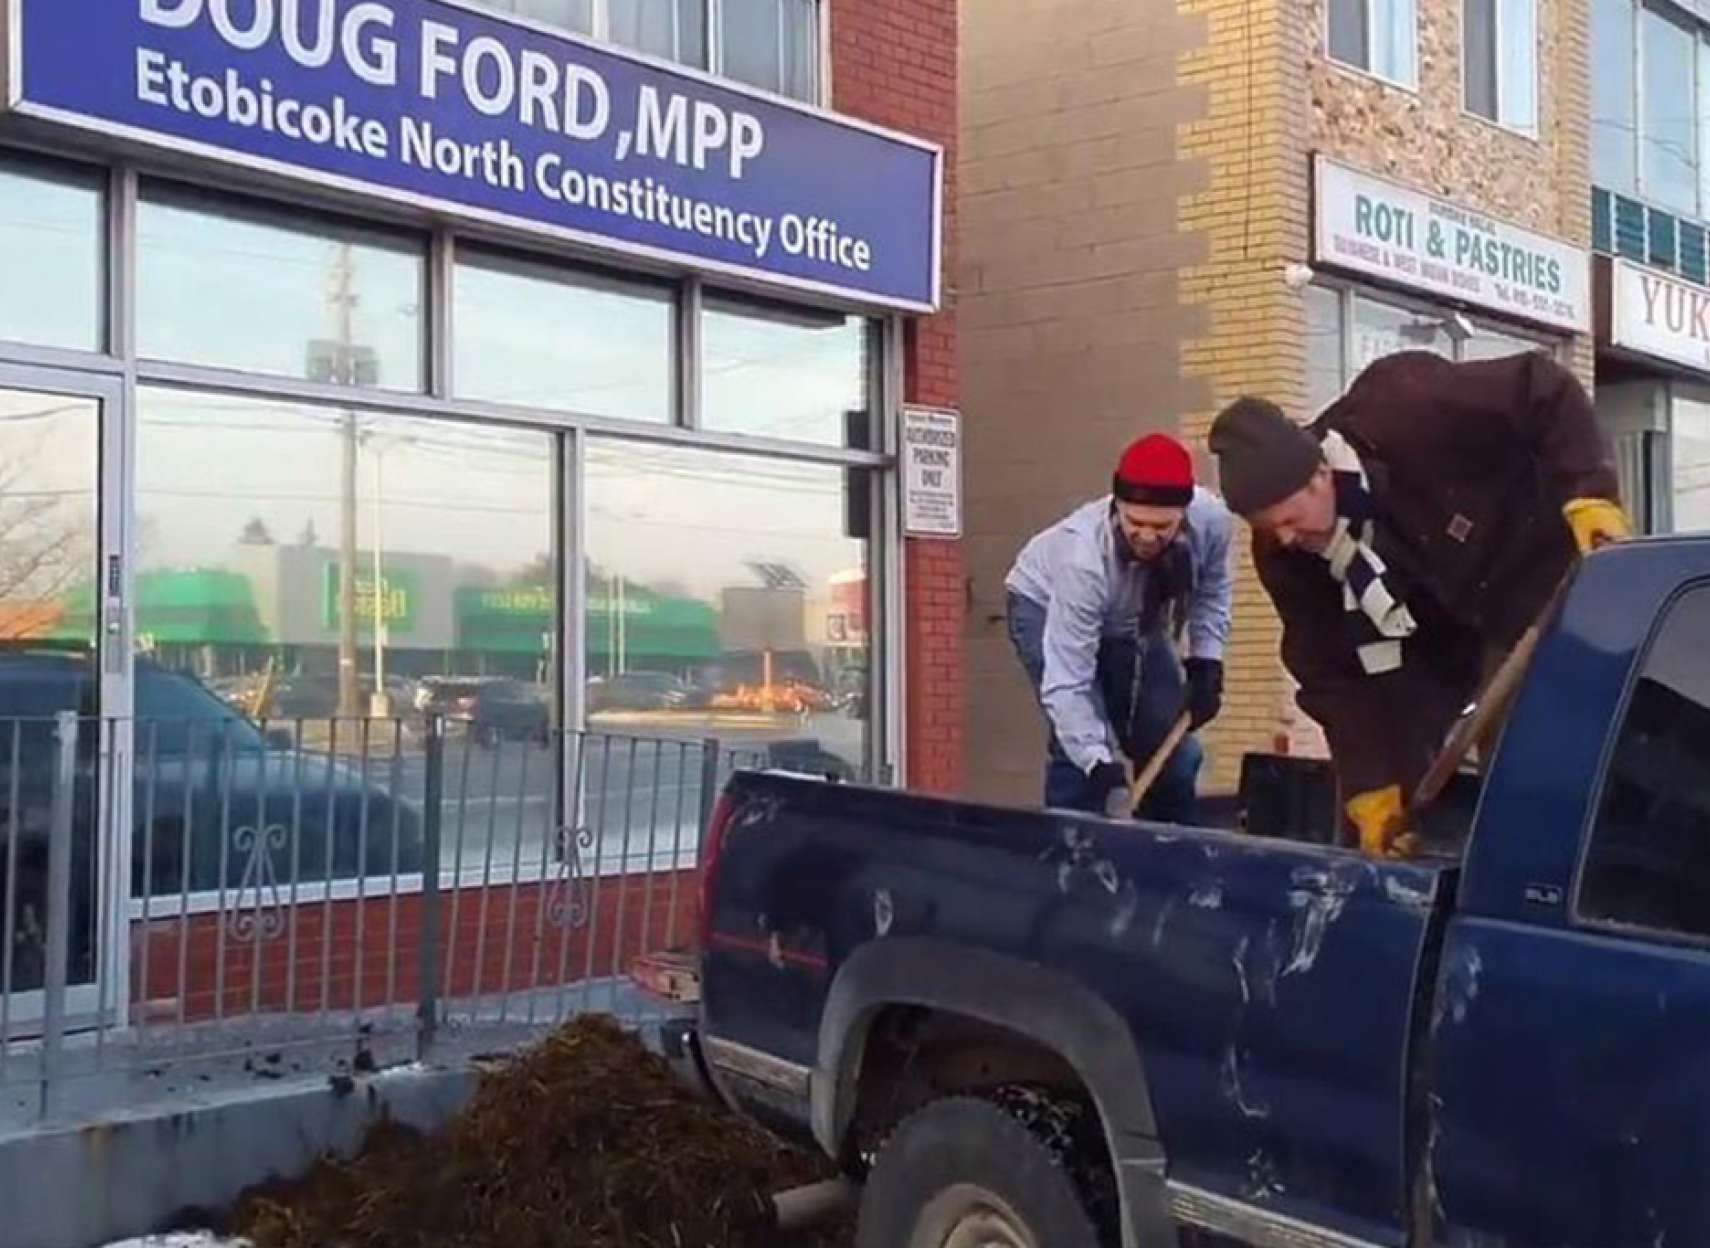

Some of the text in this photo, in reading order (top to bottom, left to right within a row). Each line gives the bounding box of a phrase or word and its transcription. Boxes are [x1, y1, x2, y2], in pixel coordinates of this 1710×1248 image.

[419, 19, 610, 140] FORD
[136, 47, 872, 271] Etobicoke North Constituency Office
[1354, 193, 1414, 250] ROTI
[1426, 218, 1445, 258] &
[1456, 228, 1560, 293] PASTRIES
[1639, 273, 1710, 341] YUK
